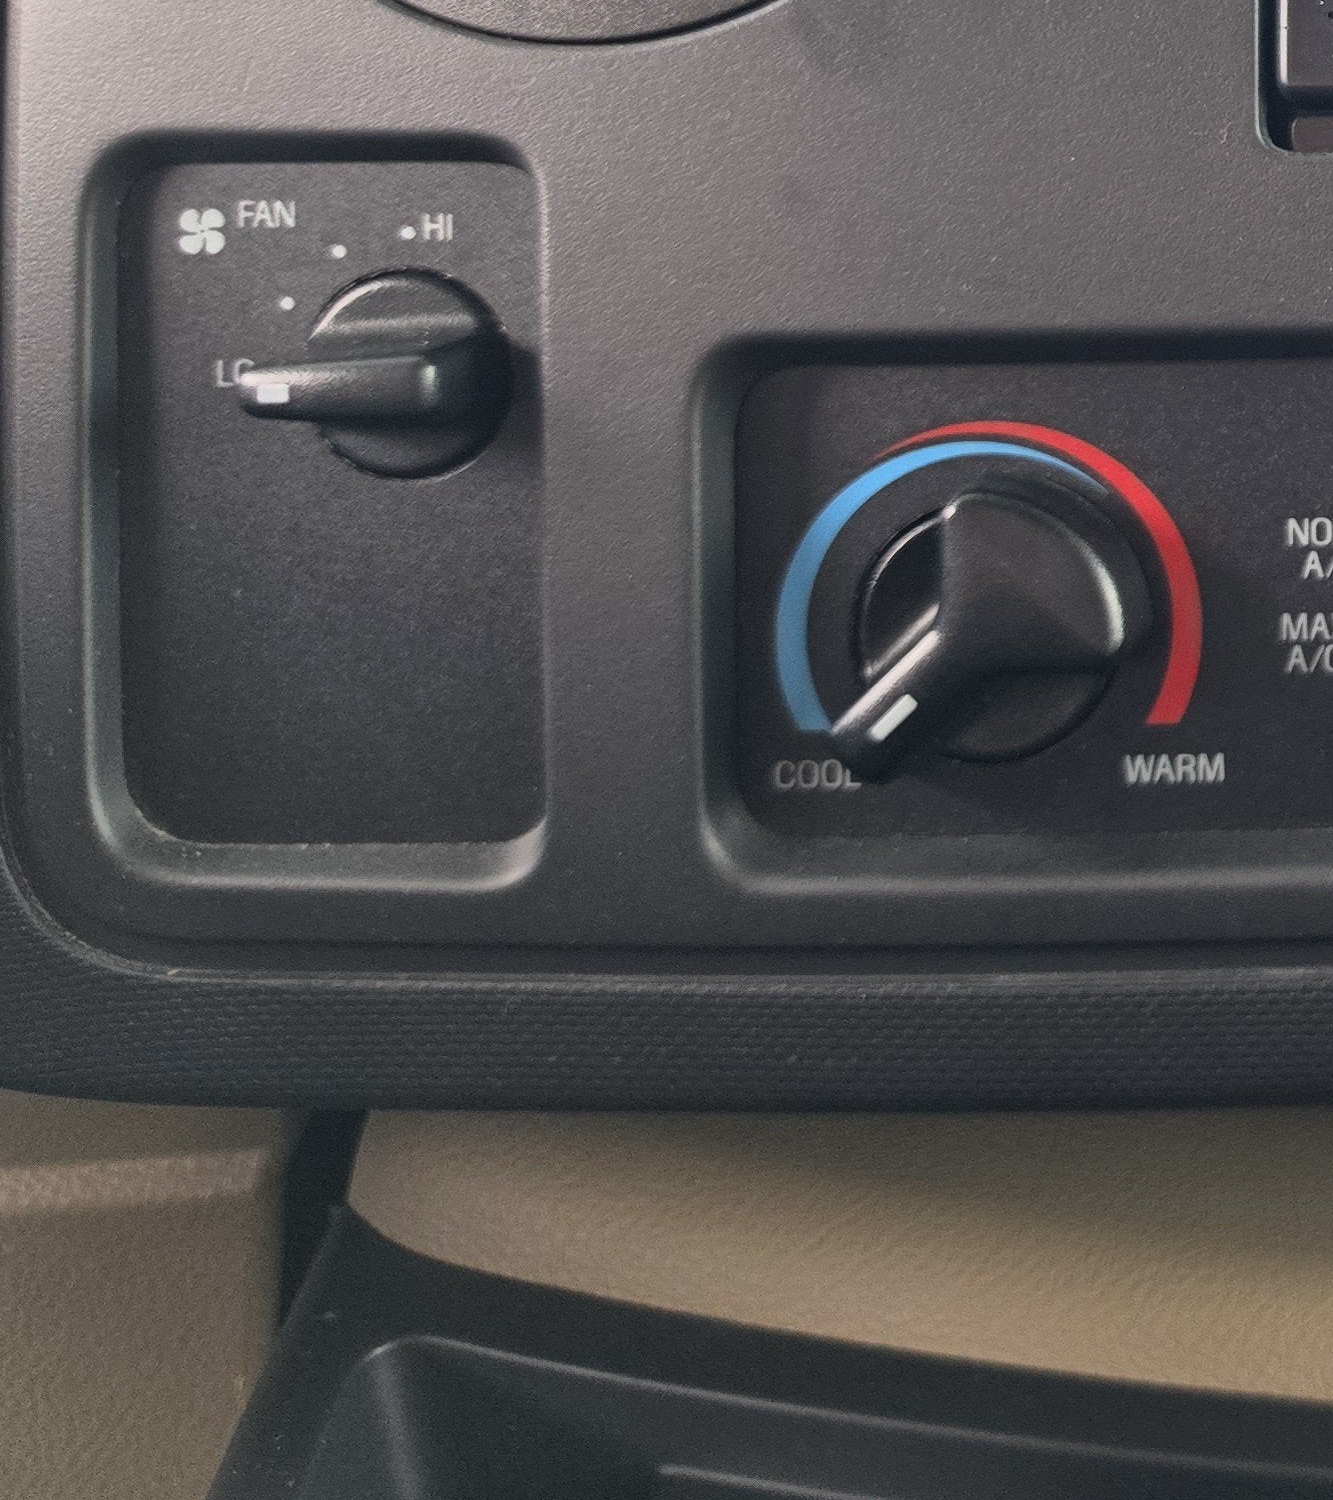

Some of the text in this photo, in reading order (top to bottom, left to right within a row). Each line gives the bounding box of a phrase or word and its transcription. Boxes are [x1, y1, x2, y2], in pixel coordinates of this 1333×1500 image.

[236, 200, 296, 227] FAN
[423, 214, 453, 241] HI
[1123, 753, 1225, 784] WARM
